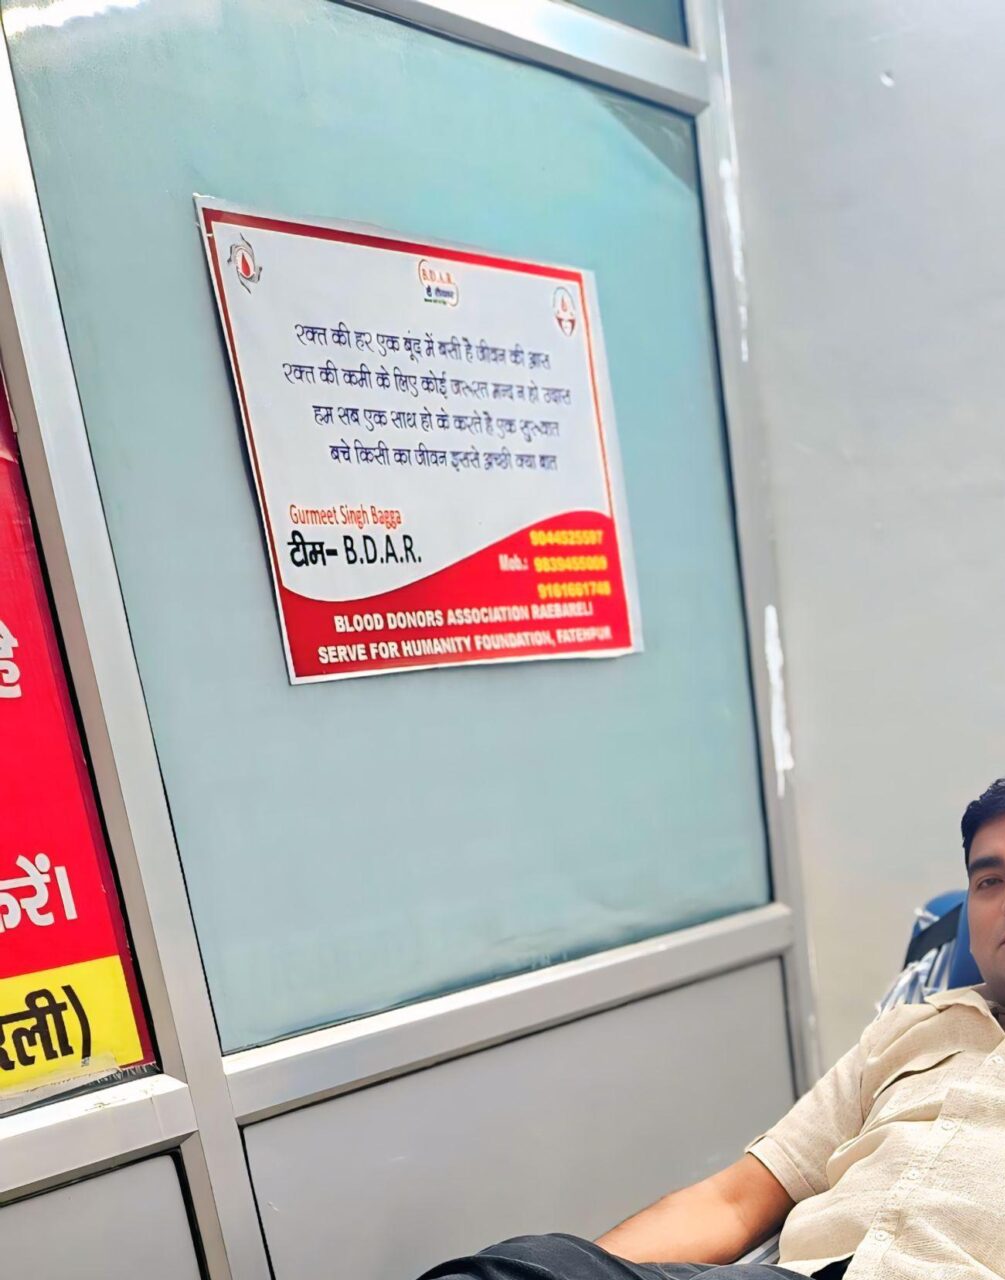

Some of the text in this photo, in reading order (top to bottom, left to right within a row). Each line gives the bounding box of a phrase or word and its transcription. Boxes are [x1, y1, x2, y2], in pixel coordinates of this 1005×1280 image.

[295, 323, 328, 346] रक्त
[330, 321, 351, 349] की
[354, 331, 374, 352] हर
[377, 332, 400, 357] एक
[282, 362, 315, 385] रक्त
[318, 359, 339, 386] की
[341, 363, 372, 389] कमी
[375, 365, 391, 390] के
[393, 366, 418, 398] लिए
[420, 370, 447, 399] कोई
[312, 404, 334, 425] हम
[338, 406, 360, 426] सब
[364, 408, 387, 432] एक
[391, 411, 417, 429] साथ
[420, 406, 432, 432] हो
[436, 407, 450, 430] के
[329, 438, 351, 463] बचे
[354, 438, 390, 466] किसी
[393, 448, 412, 466] का
[414, 442, 447, 467] जीवन
[289, 504, 402, 530] Gurmeet Singh Bagga
[343, 534, 422, 564] B.D.A.R.
[334, 613, 384, 633] BLOOD
[386, 610, 444, 630] DONORS
[447, 604, 530, 626] ASSOCIATION
[318, 644, 368, 664] SERVE
[369, 641, 400, 660] FOR
[401, 635, 471, 657] HUMANITY
[474, 630, 556, 651] FOUNDATION,
